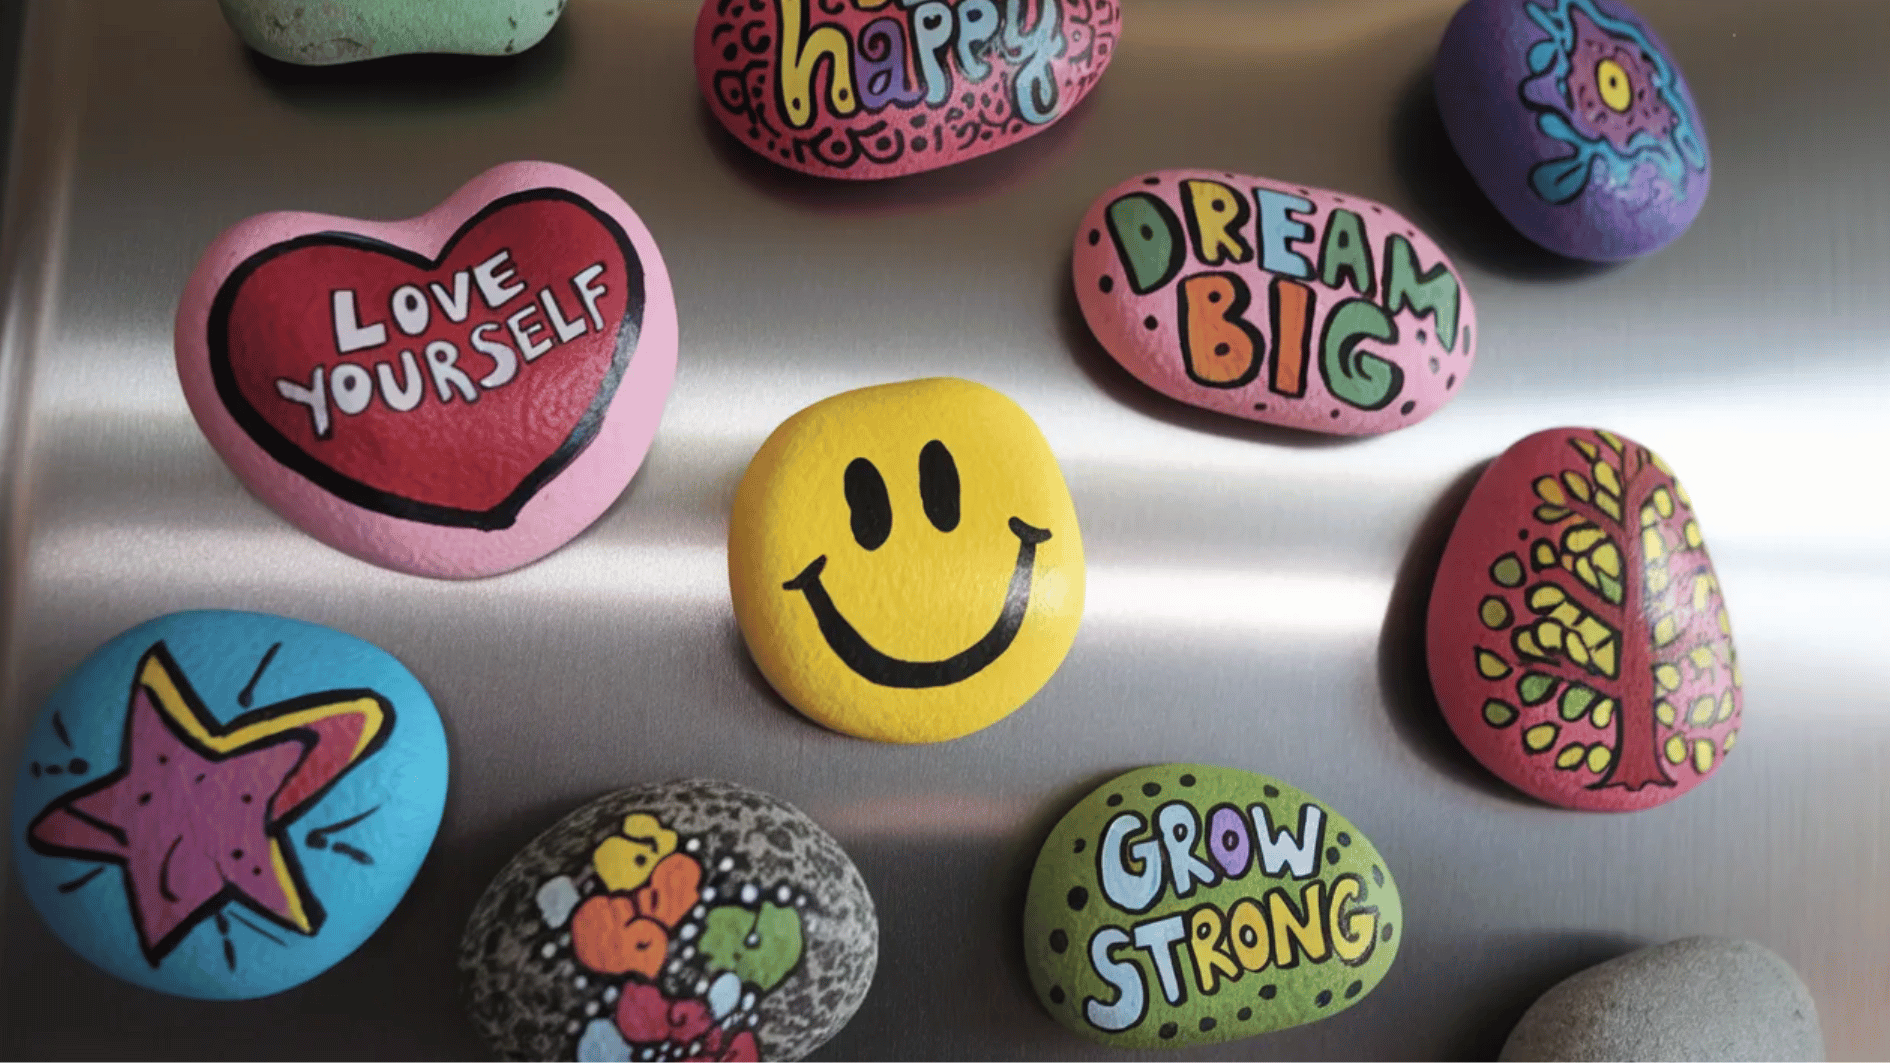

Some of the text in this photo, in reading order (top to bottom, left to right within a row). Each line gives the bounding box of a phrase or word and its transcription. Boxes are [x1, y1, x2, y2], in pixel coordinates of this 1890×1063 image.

[775, 0, 1067, 127] happy
[333, 250, 525, 354] LOVE
[1105, 179, 1460, 353] DREAM
[275, 263, 608, 438] YOURSELF
[1177, 271, 1404, 411] BIG
[1096, 800, 1327, 914] GROW
[1083, 873, 1380, 1033] STRONG
